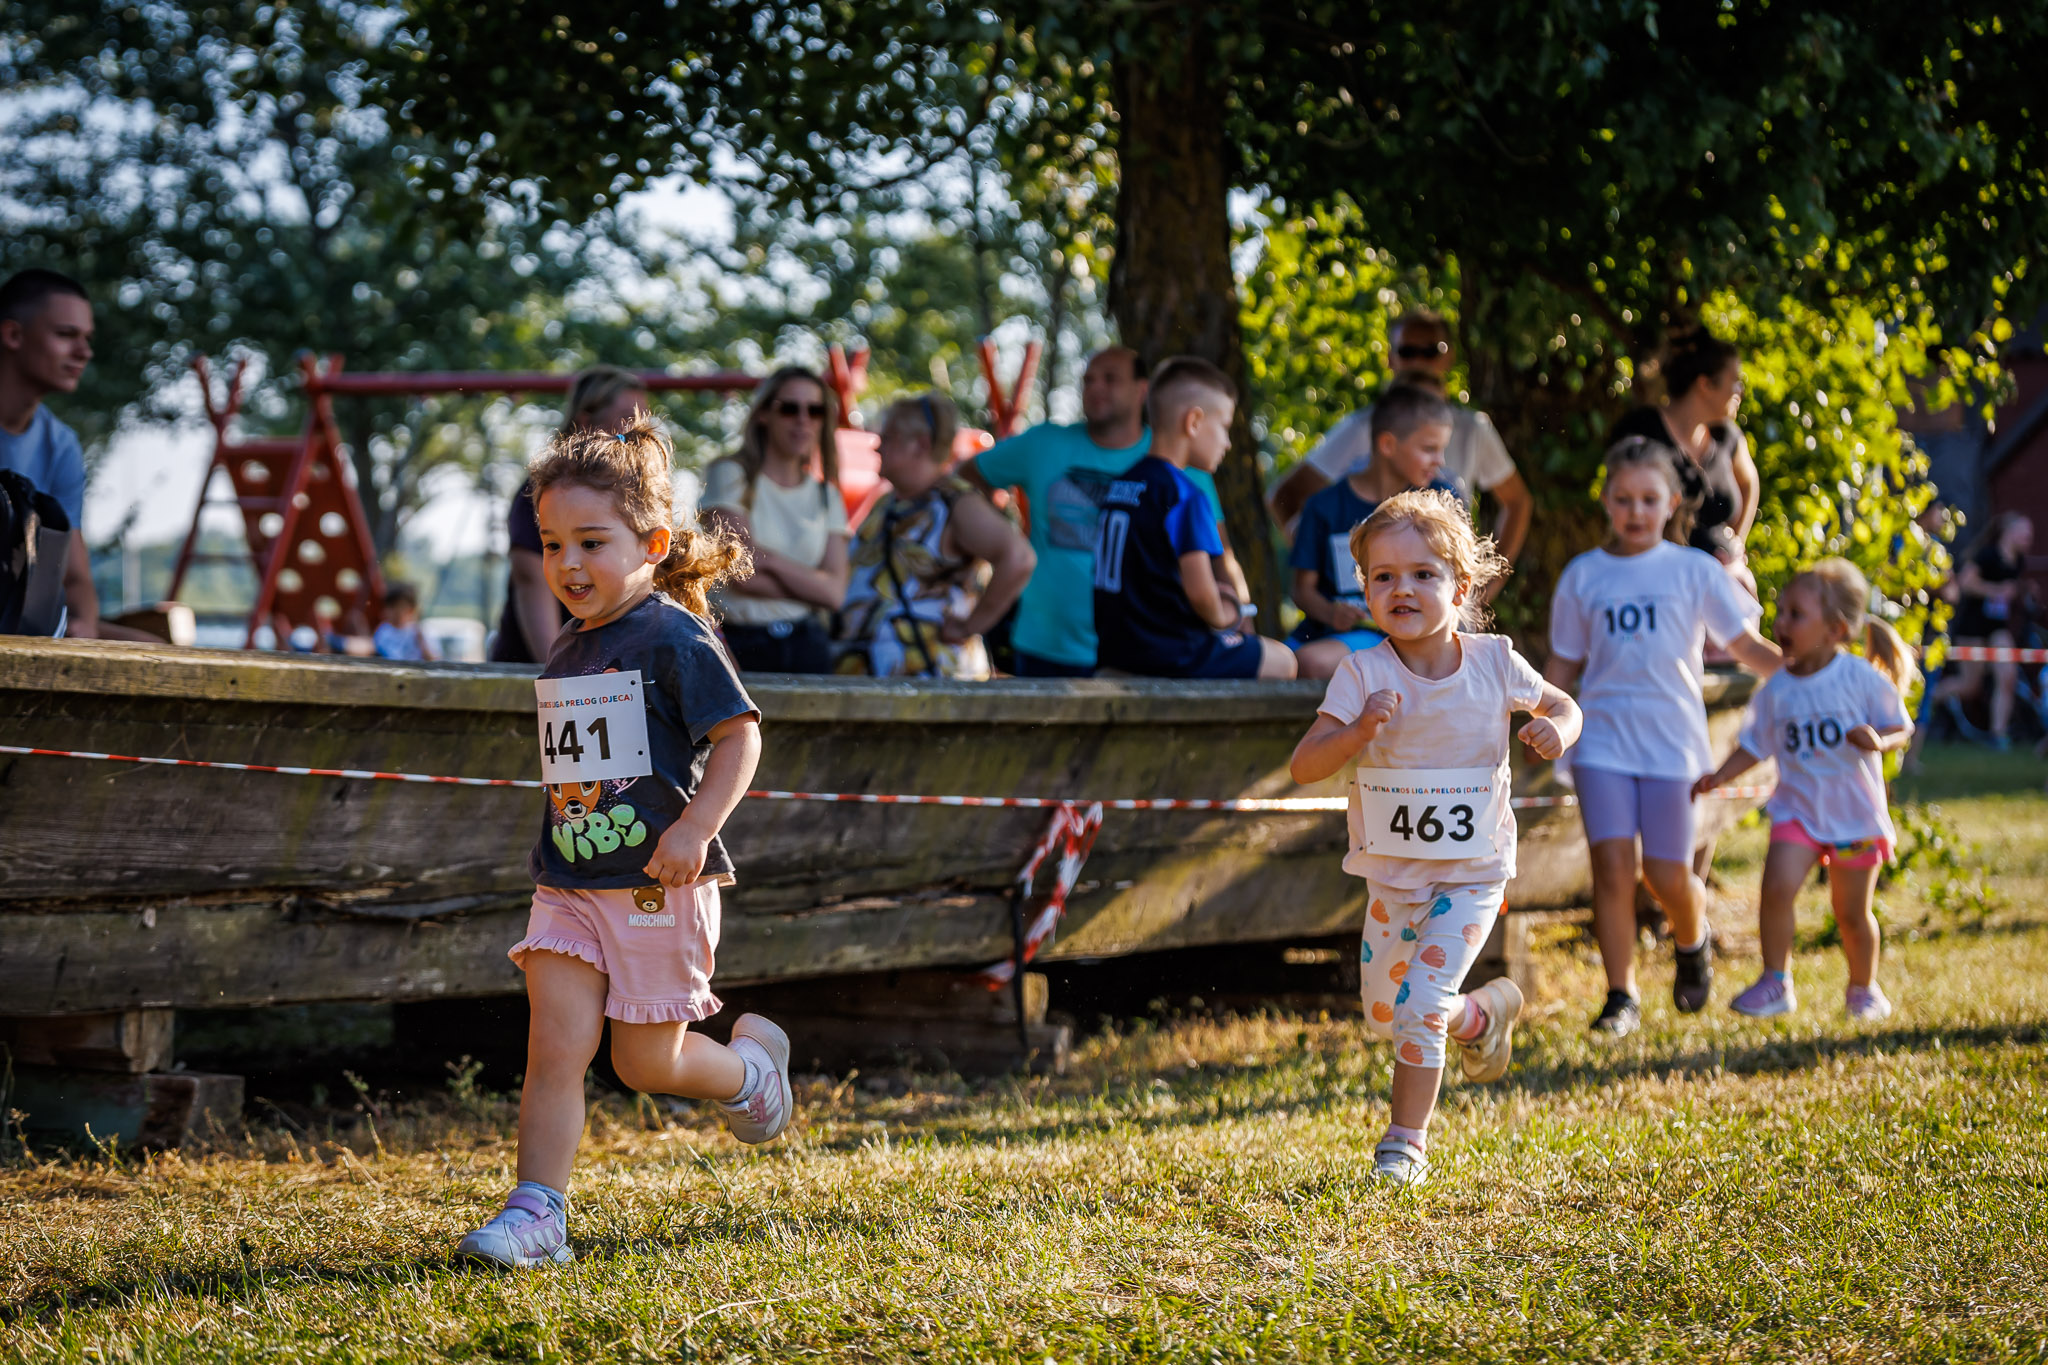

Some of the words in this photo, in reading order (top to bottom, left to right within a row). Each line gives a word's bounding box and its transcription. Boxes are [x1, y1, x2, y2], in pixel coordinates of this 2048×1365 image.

[1605, 604, 1656, 635] 101
[565, 697, 597, 708] PRELOG
[599, 694, 634, 705] (DJECA)
[544, 717, 611, 764] 441
[1785, 718, 1842, 753] 310
[1367, 785, 1390, 793] LJETNA
[1391, 786, 1410, 794] KROS
[1431, 786, 1461, 794] PRELOG
[1463, 785, 1491, 794] (DJECA)
[1390, 804, 1474, 842] 463
[628, 914, 676, 928] MOSCHINO
